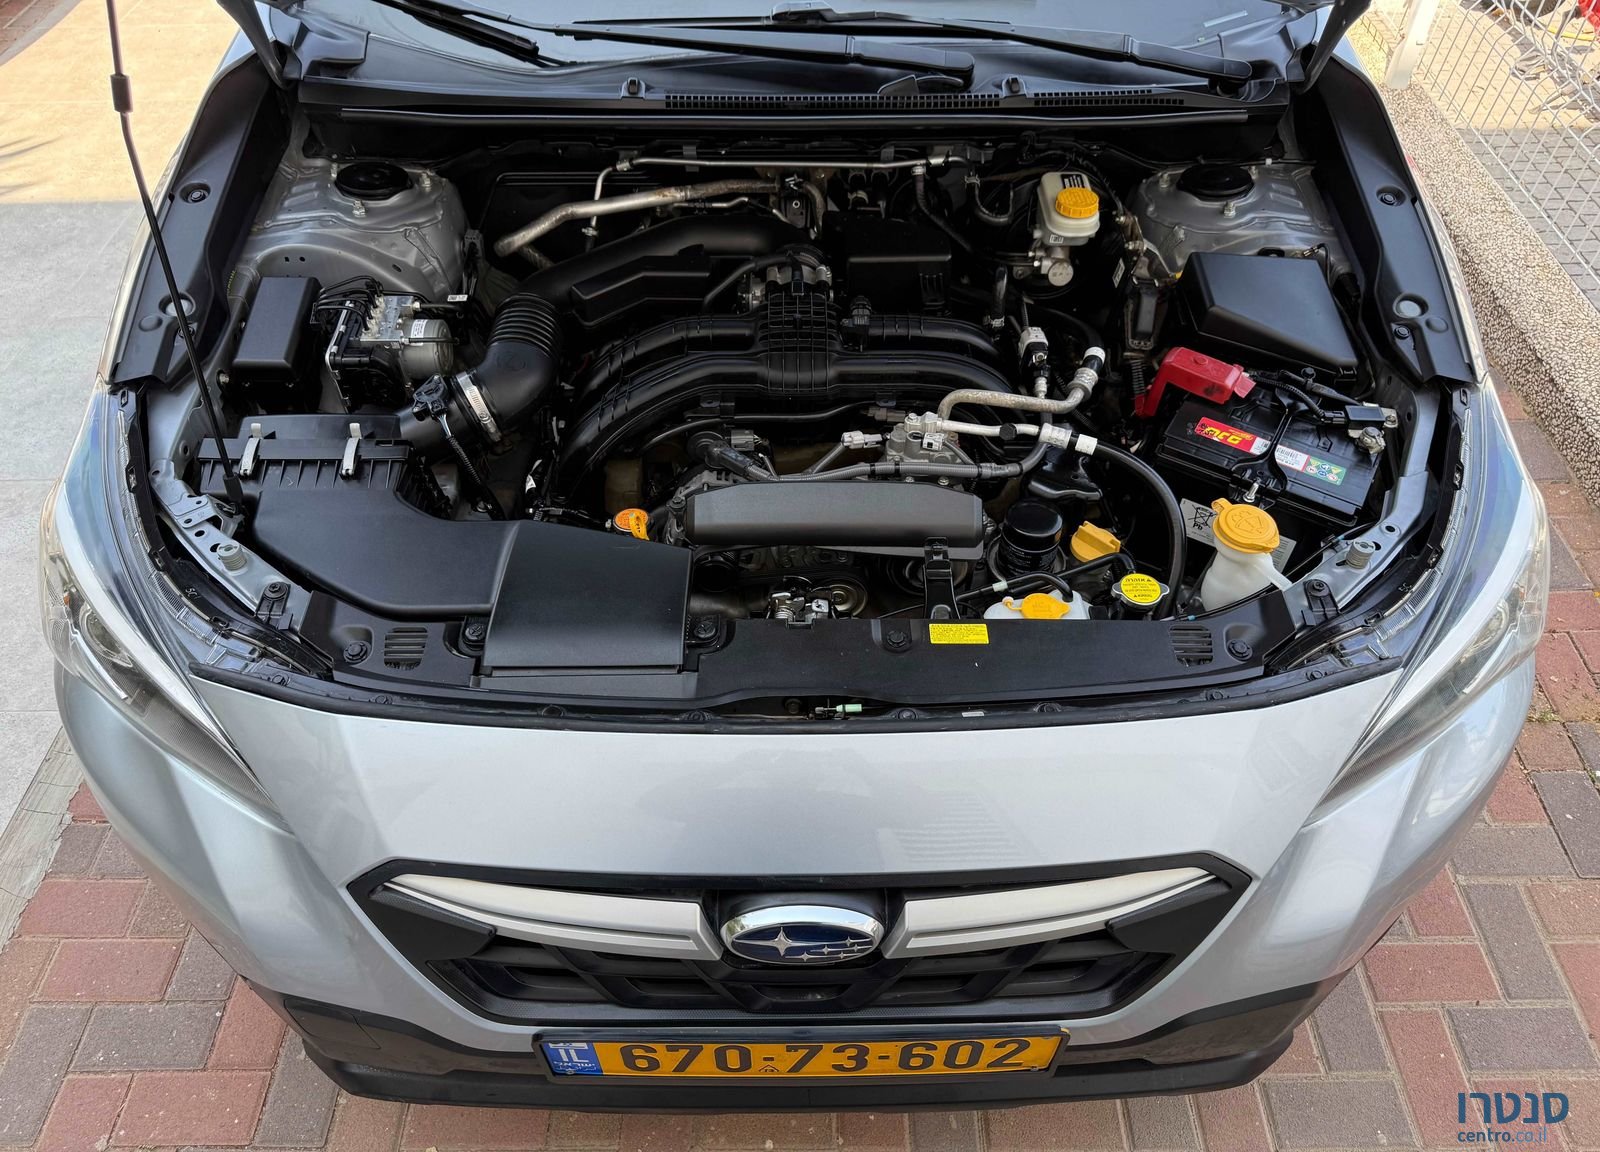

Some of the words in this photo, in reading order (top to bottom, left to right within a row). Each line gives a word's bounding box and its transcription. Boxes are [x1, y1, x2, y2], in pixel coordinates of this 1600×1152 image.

[1192, 522, 1203, 531] Pb
[558, 1048, 590, 1063] IL
[619, 1038, 1031, 1073] 670-73-602
